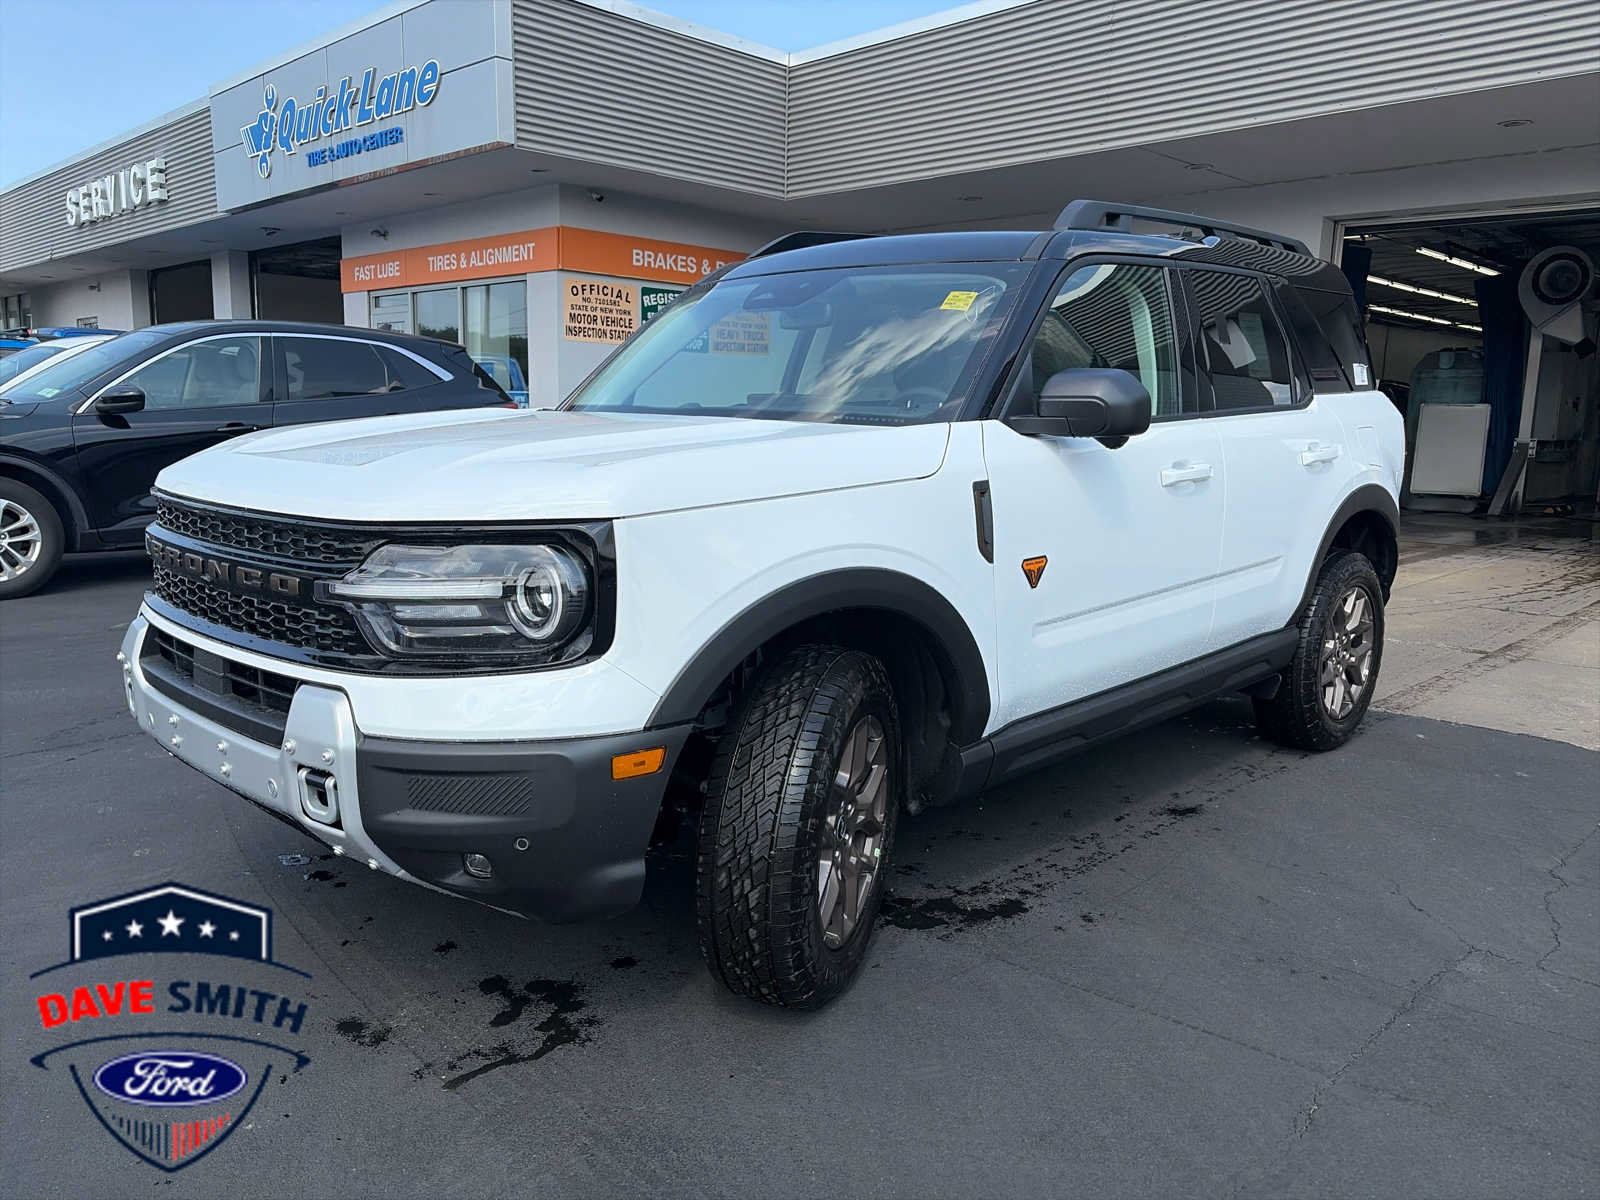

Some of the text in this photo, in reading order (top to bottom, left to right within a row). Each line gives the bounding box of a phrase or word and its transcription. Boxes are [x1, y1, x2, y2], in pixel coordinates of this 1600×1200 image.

[277, 59, 440, 155] Quick Lane
[306, 148, 327, 168] TIRE
[335, 140, 361, 160] AUTO
[361, 125, 404, 152] CENTER
[66, 157, 169, 227] SERVICE
[427, 243, 536, 272] TIRES & ALIGNMENT
[632, 249, 697, 274] BRAKES
[701, 259, 711, 275] &
[354, 261, 400, 281] FAST LUBE
[571, 284, 631, 304] OFFICIAL
[569, 312, 598, 326] MOTOR
[600, 315, 633, 329] VEHICLE
[570, 304, 588, 312] STATE
[615, 308, 632, 316] YORK
[565, 324, 608, 338] INSPECTION
[150, 539, 301, 596] BRONCO
